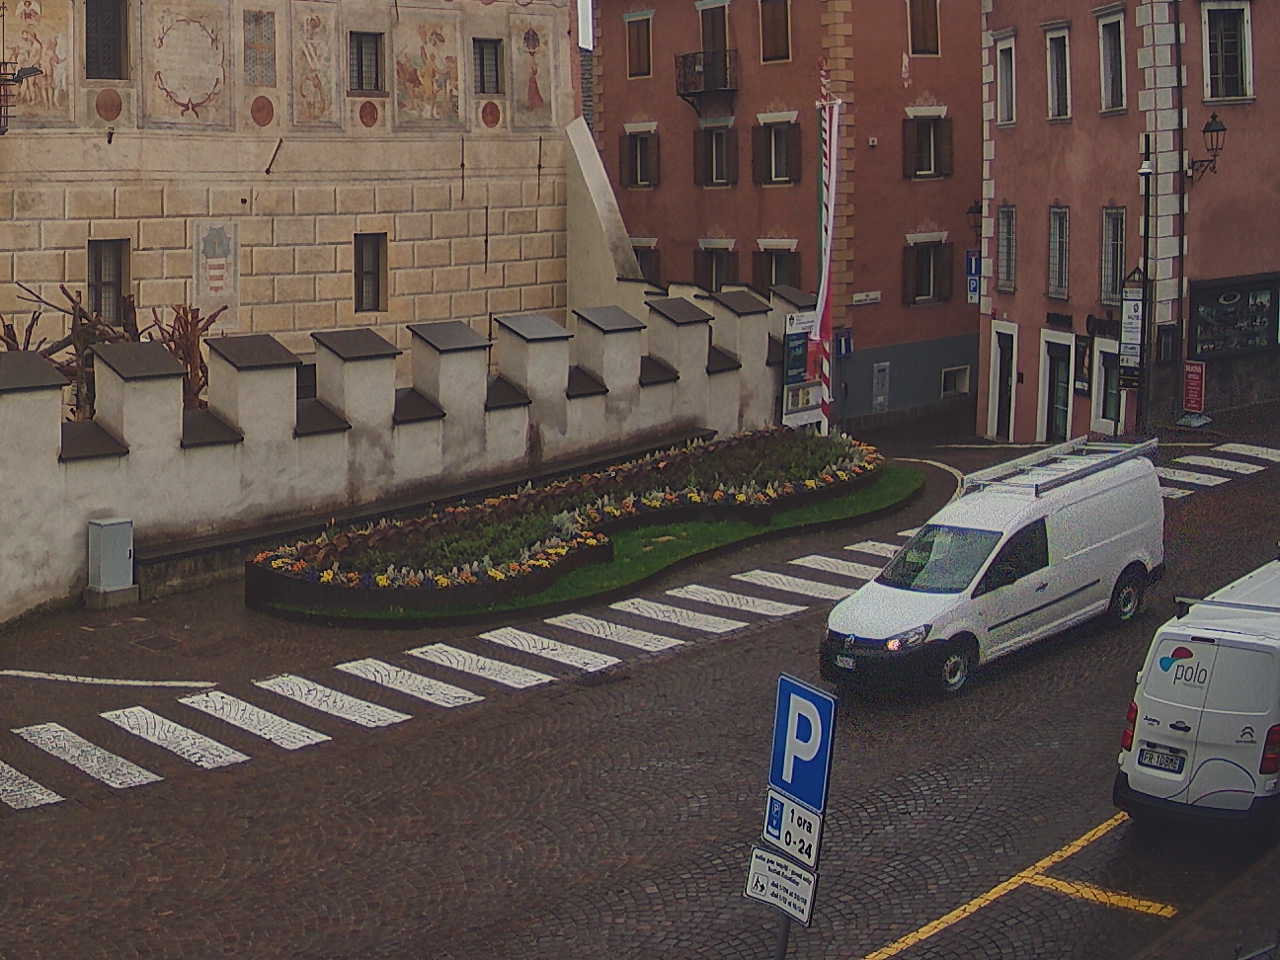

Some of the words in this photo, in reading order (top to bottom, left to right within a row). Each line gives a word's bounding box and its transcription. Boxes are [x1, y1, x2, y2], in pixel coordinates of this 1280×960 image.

[1173, 662, 1208, 685] polo
[781, 692, 822, 784] P
[791, 808, 795, 824] 1
[796, 815, 813, 834] ora
